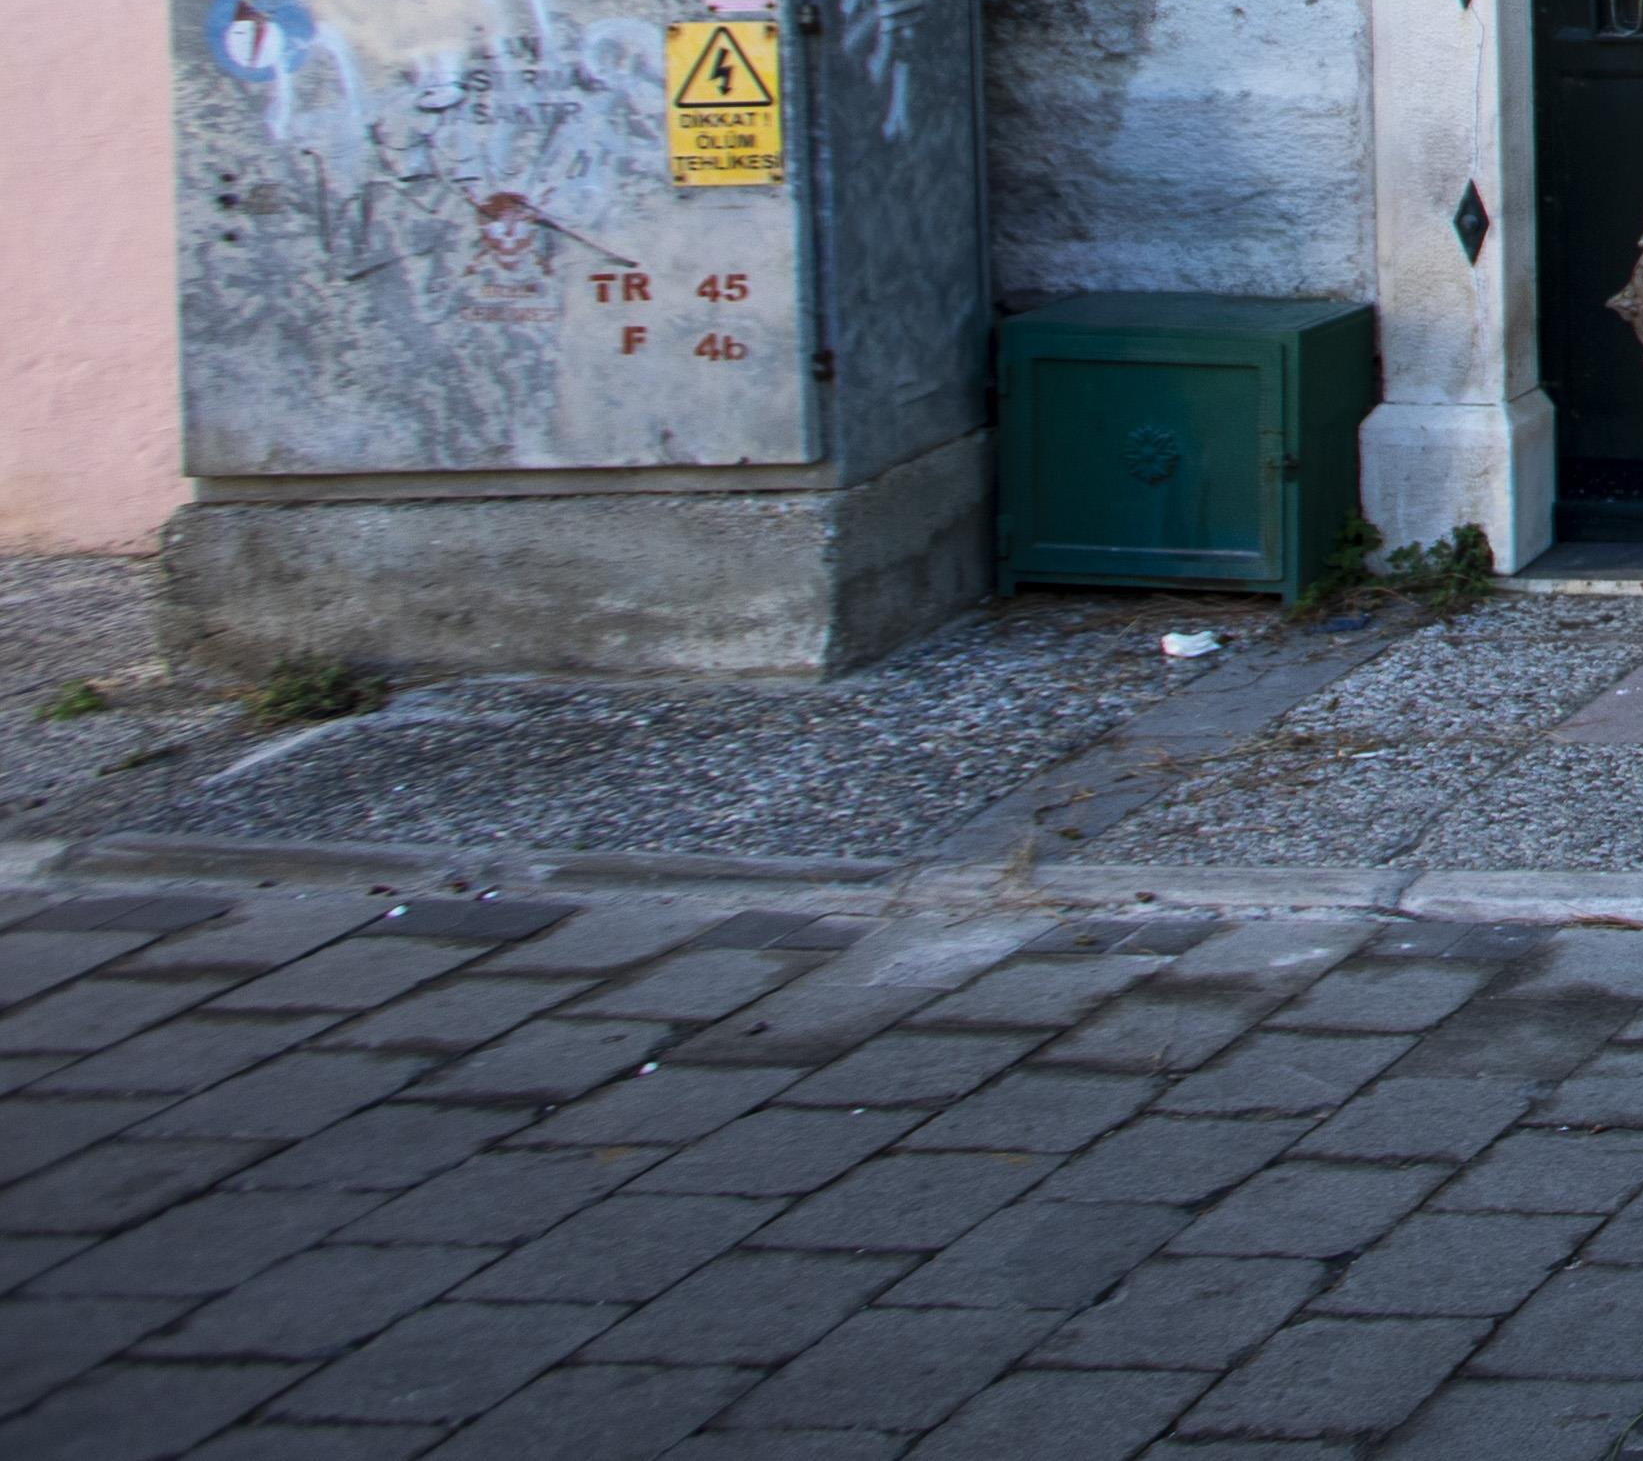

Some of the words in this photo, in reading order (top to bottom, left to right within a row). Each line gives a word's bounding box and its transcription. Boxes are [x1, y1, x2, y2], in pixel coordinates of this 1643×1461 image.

[589, 272, 652, 303] TR
[696, 274, 749, 302] 45
[621, 326, 647, 355] F
